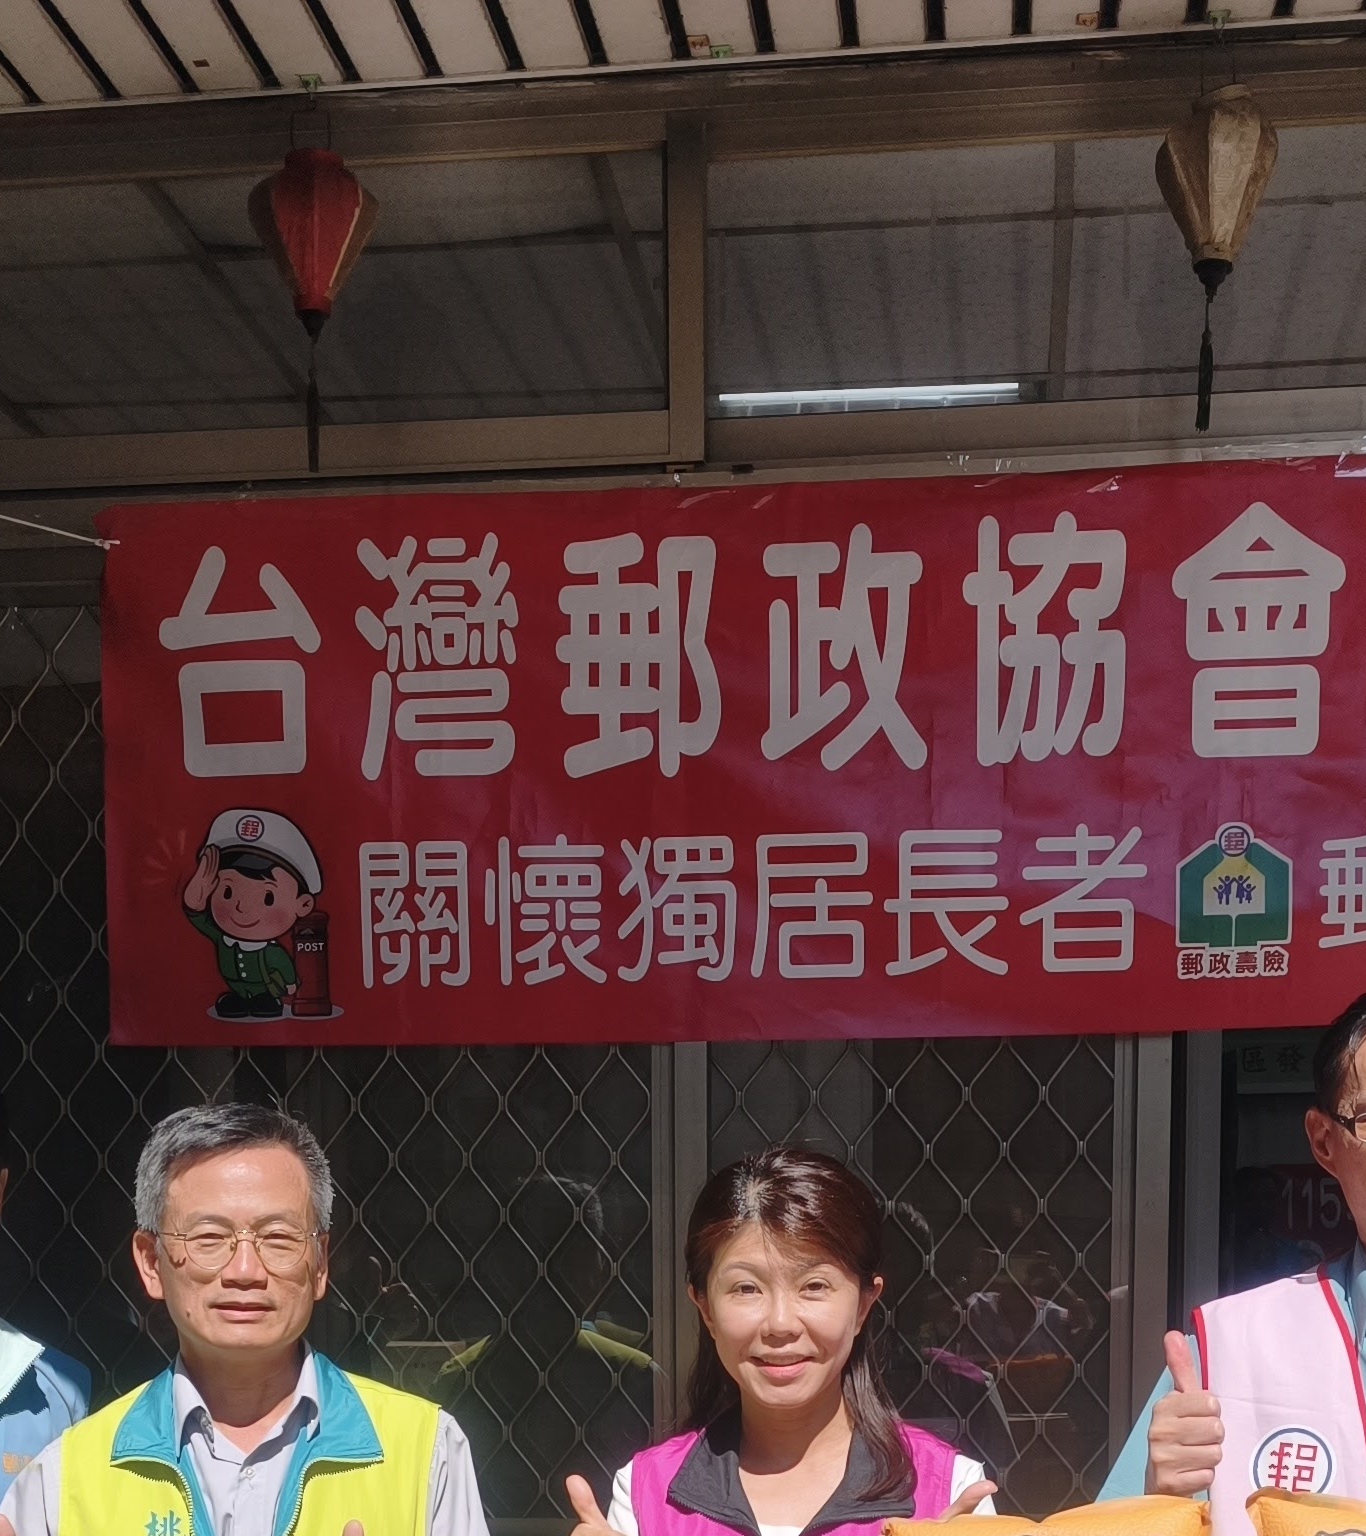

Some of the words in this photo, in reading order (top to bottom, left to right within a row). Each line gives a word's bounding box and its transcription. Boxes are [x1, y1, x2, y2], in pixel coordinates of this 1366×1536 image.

[357, 823, 1148, 988] 關懷獨居長者
[297, 942, 324, 951] POST
[1181, 951, 1285, 976] 郵政壽險
